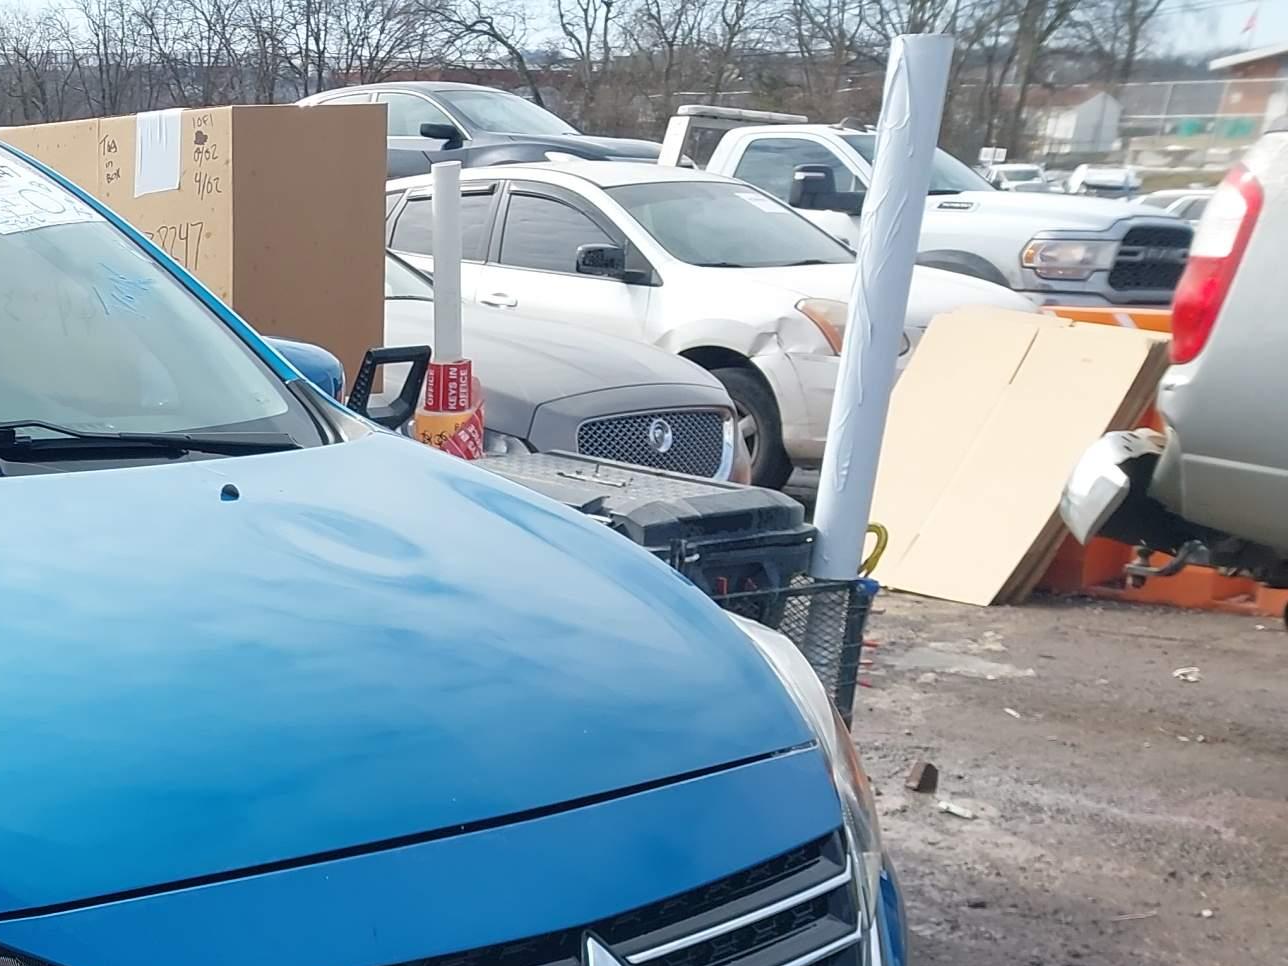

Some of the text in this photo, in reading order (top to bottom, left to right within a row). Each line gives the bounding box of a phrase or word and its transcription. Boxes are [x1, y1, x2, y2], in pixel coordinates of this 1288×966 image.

[447, 367, 458, 410] KEYS IN
[458, 368, 469, 407] OFFICE
